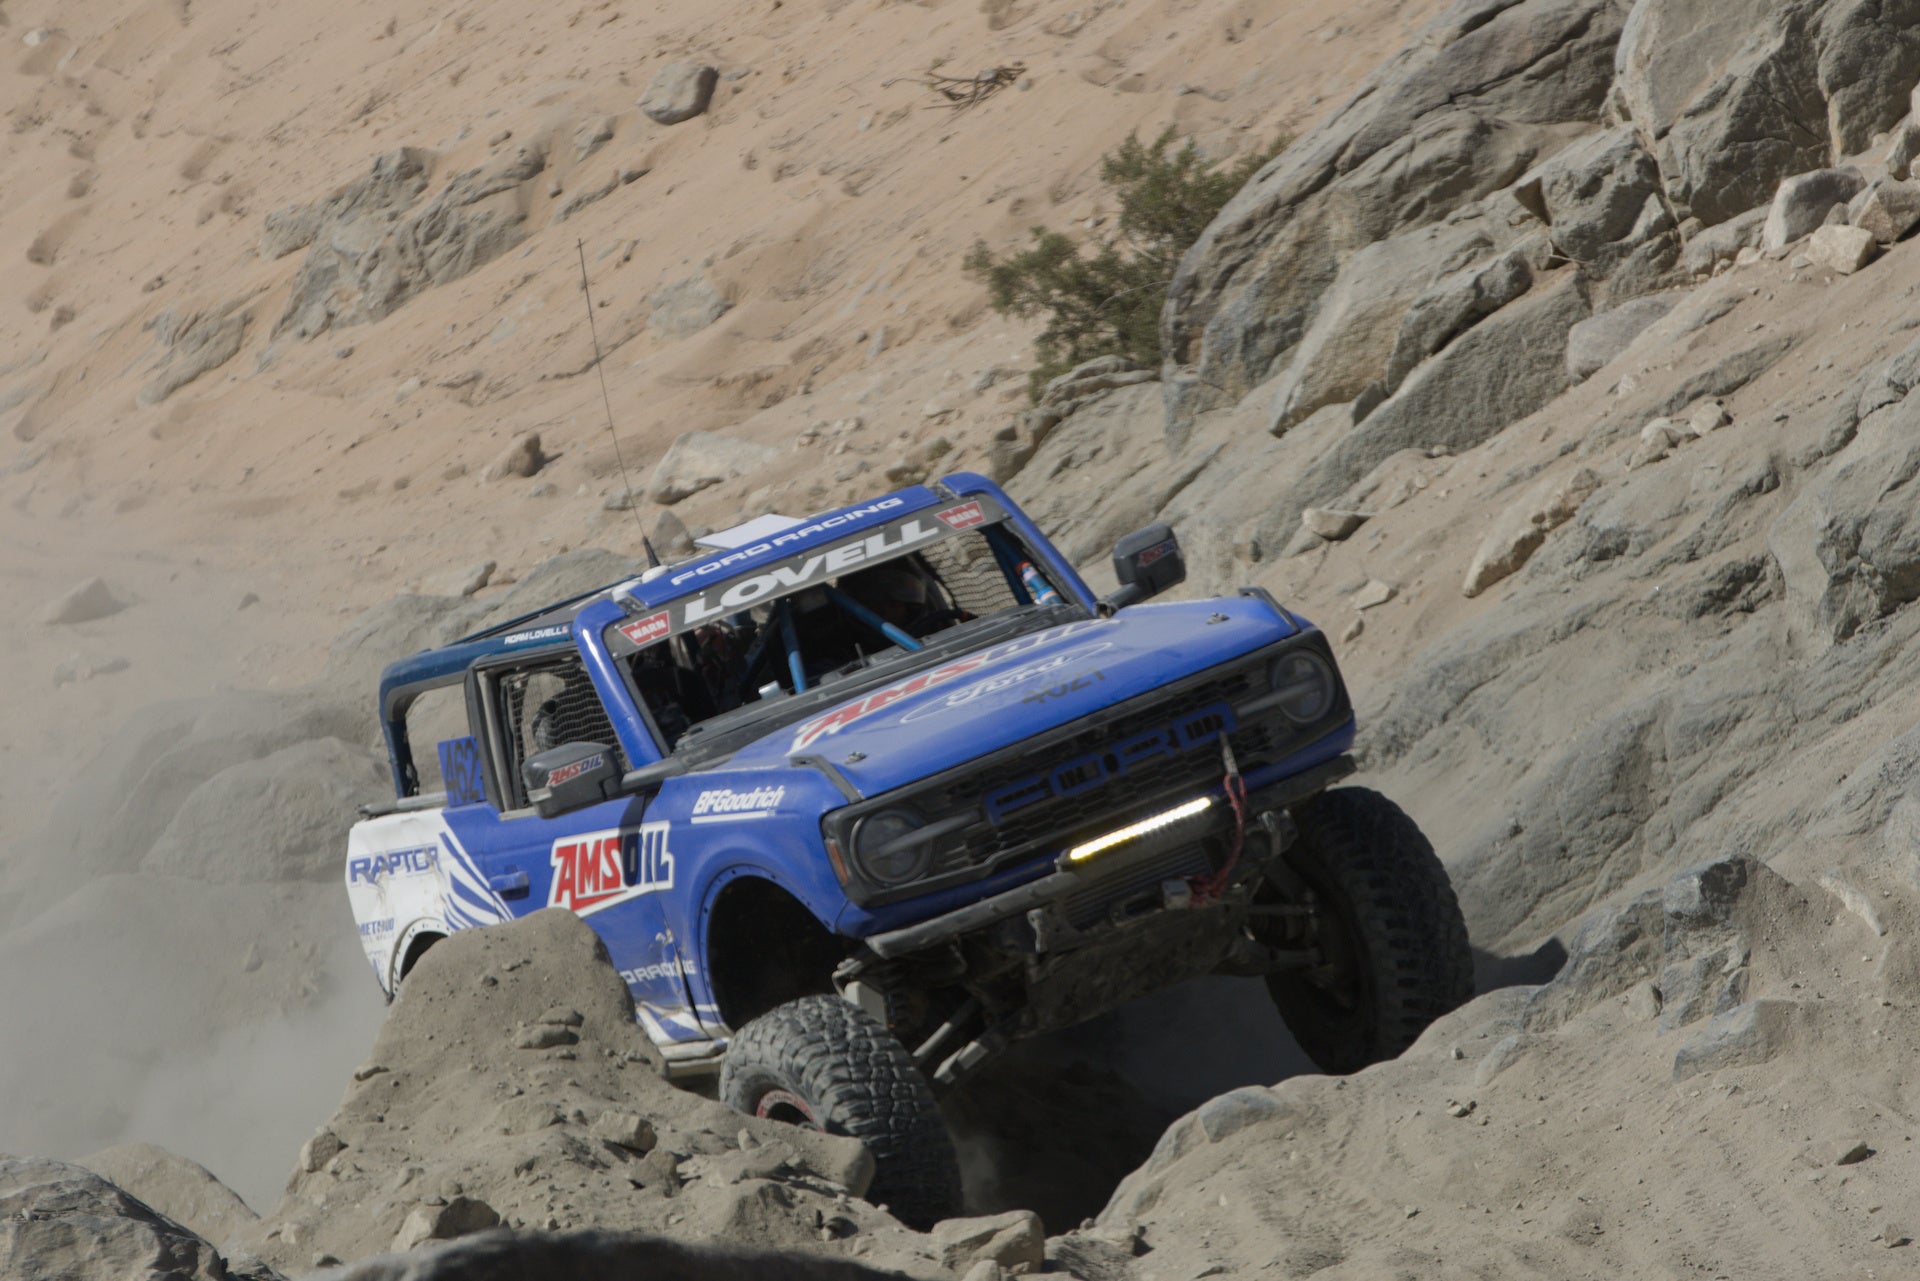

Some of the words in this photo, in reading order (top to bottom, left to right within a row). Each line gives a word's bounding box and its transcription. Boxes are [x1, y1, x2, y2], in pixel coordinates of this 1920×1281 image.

[945, 508, 981, 525] WARN
[671, 543, 772, 586] FORD
[774, 497, 905, 546] RACING
[684, 520, 939, 624] LOVELL
[529, 626, 562, 640] LOVELL
[629, 619, 667, 640] WARN
[787, 618, 1119, 755] AMSOIL
[946, 655, 1073, 707] Ford
[547, 754, 603, 787] AMSOIL
[984, 701, 1238, 826] FORD
[692, 785, 785, 815] BFGoodrich
[350, 845, 441, 884] RAPTOR
[550, 822, 674, 914] AMSOIL
